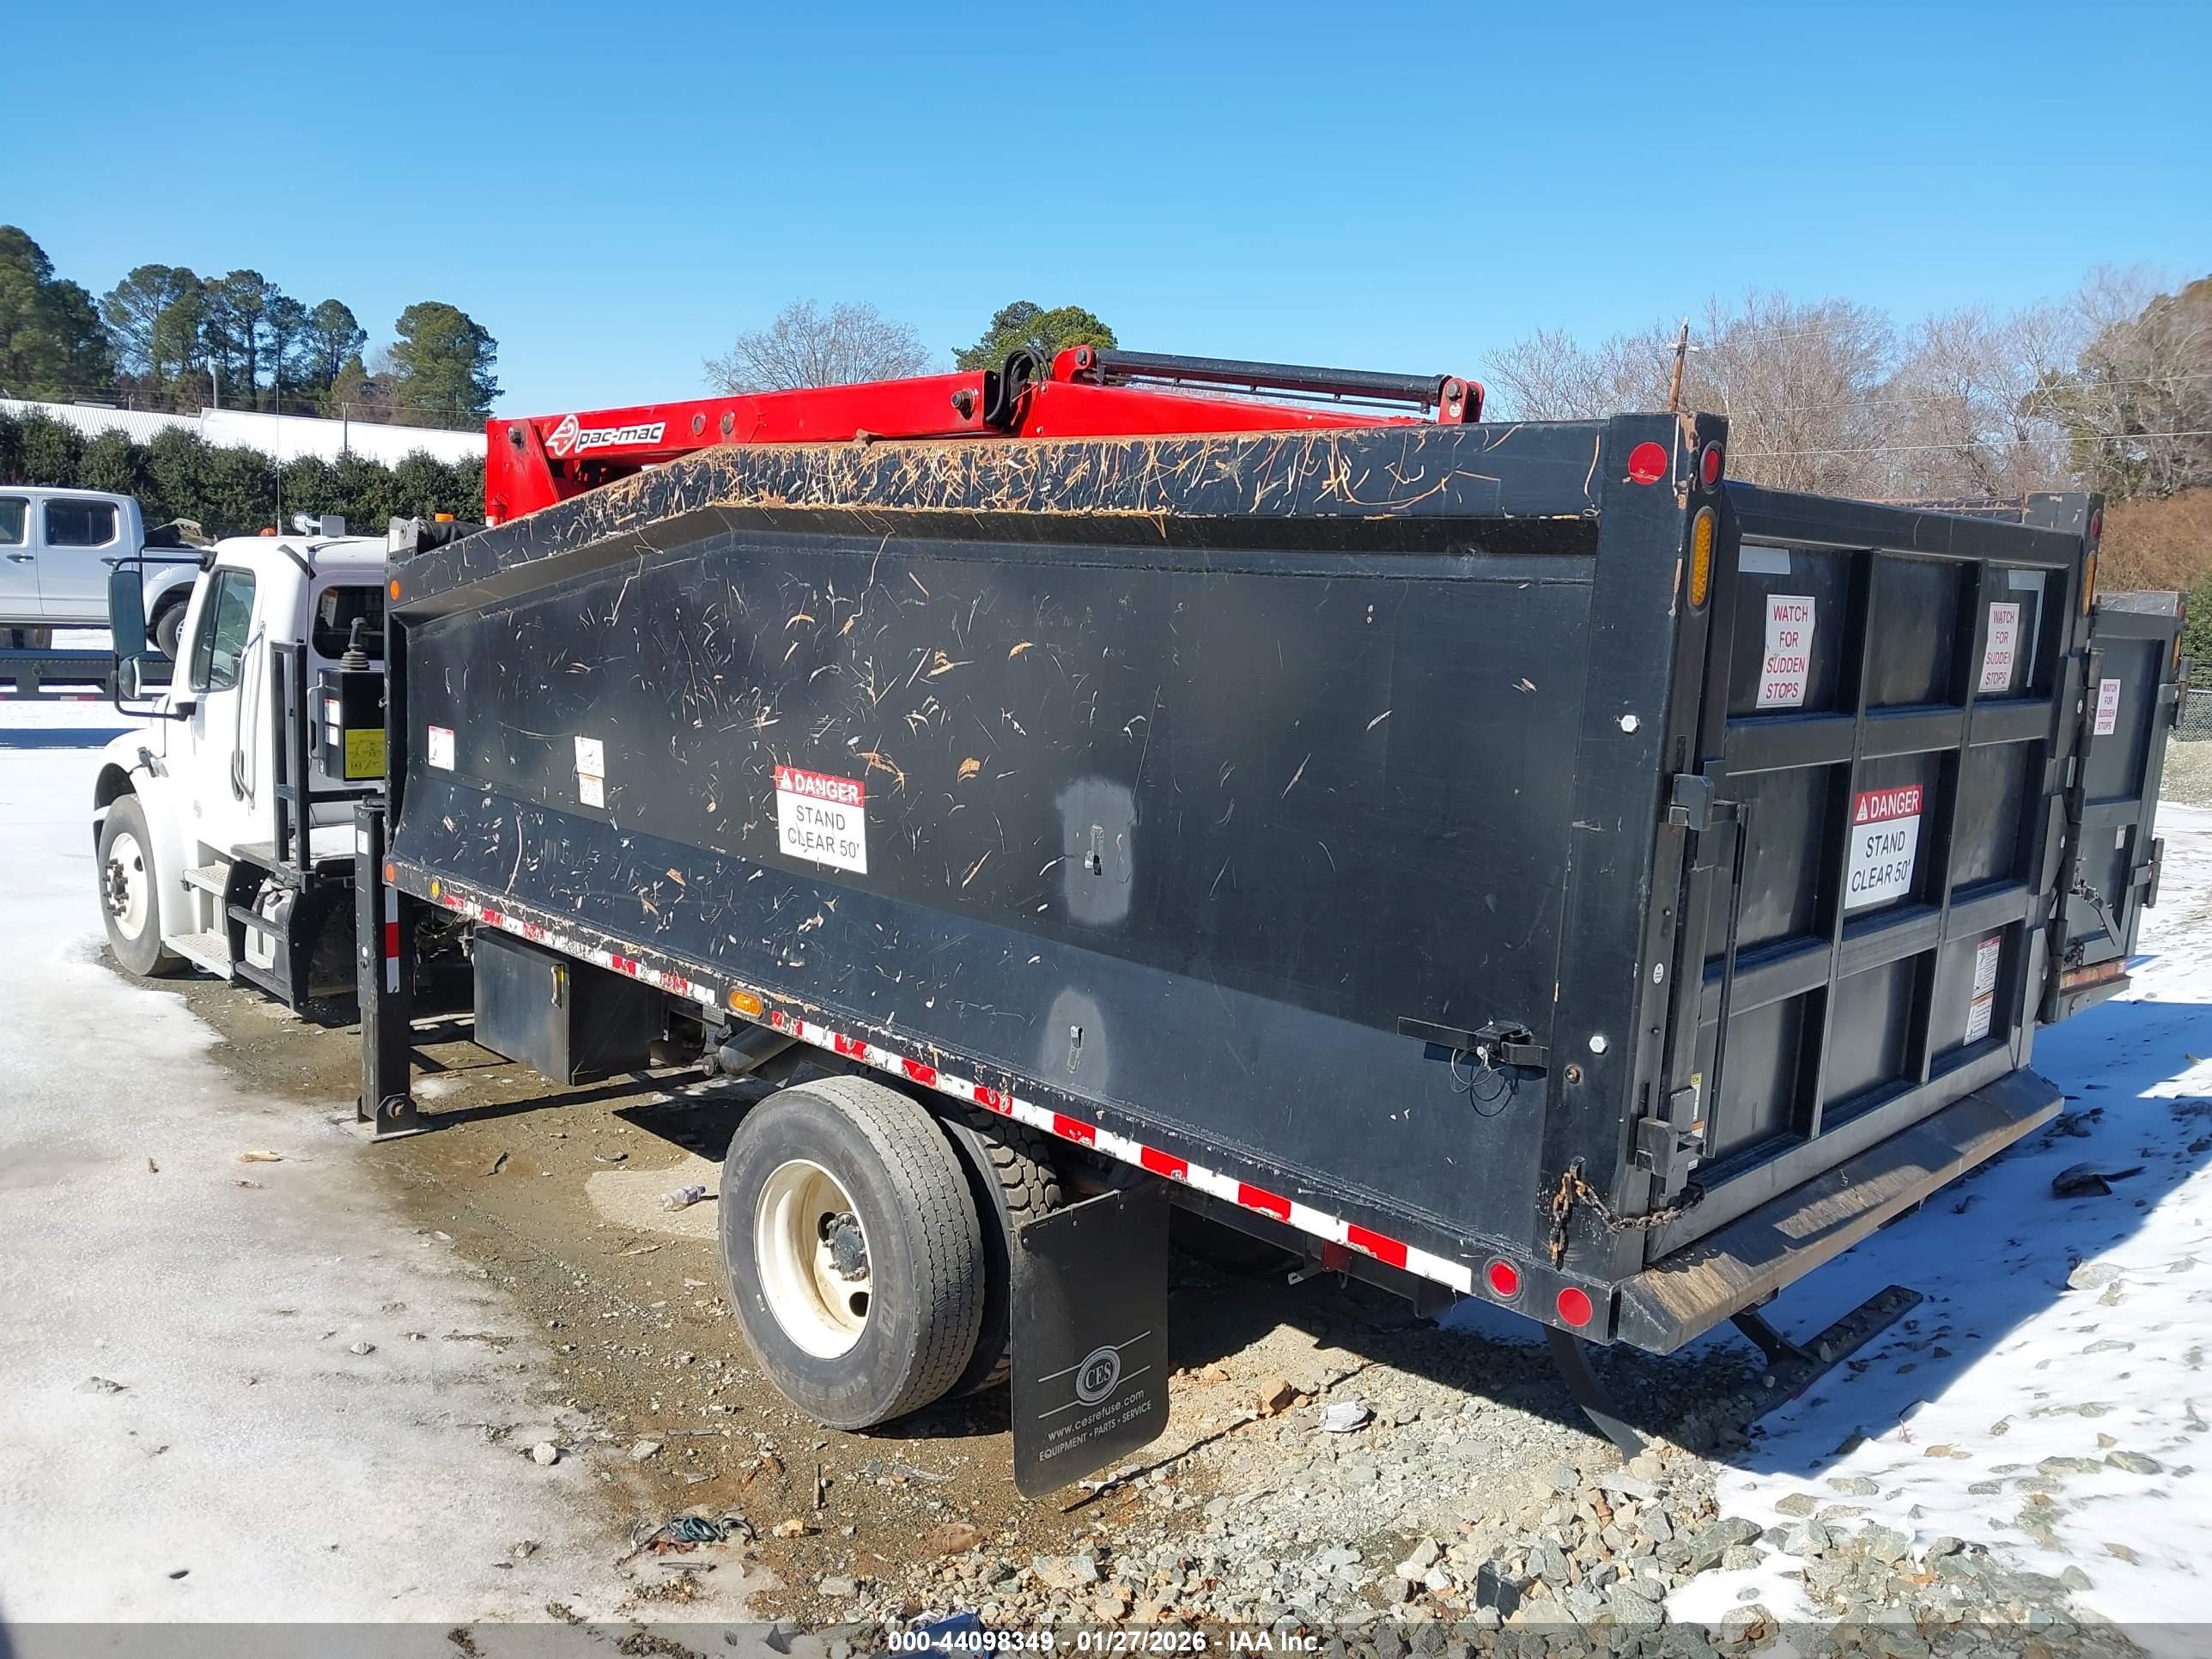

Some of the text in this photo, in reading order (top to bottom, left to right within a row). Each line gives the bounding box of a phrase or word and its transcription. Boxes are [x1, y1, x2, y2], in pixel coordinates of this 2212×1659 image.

[577, 424, 663, 450] pac-mac
[1773, 605, 1808, 623] WATCH
[1993, 611, 2015, 624] WATCH
[1779, 631, 1799, 647] FOR
[1996, 631, 2009, 644] FOR
[1766, 657, 1806, 674] SUDDEN
[1985, 672, 2007, 685] STOPS
[1765, 682, 1799, 699] STOPS
[794, 773, 860, 804] DANGER
[1870, 790, 1919, 818] DANGER
[796, 805, 846, 830] STAND
[787, 827, 860, 859] CLEAR 50'
[1866, 830, 1905, 858] STAND
[1851, 859, 1911, 892] CLEAR 50'
[1085, 1362, 1112, 1389] CES
[1048, 1389, 1145, 1442] www.cesrefuse.com
[1039, 1400, 1152, 1462] EQUIPMENT PARTS SERVICE
